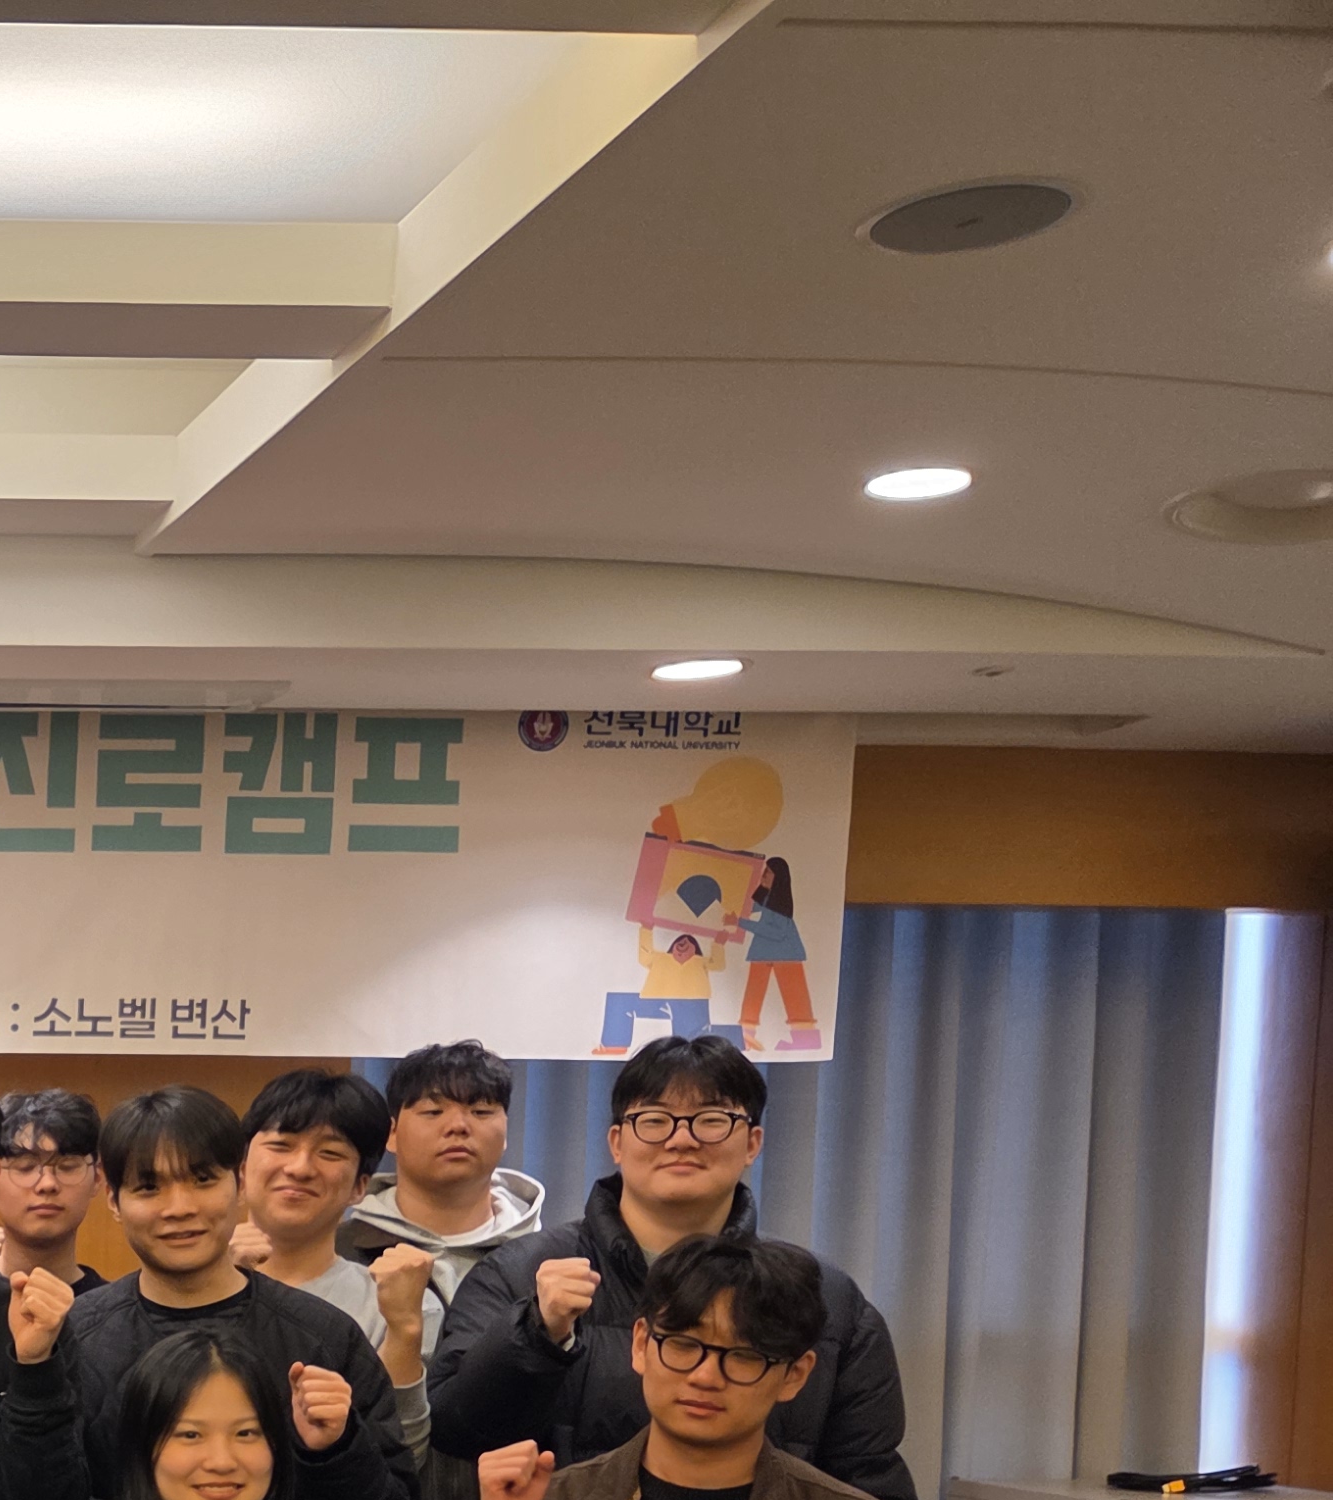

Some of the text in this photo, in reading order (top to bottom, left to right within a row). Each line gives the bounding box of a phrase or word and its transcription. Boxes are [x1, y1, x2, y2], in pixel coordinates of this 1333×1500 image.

[631, 740, 679, 750] NATIONAL
[682, 741, 741, 751] UNIVERSITY
[33, 998, 156, 1038] 소노벨
[171, 999, 250, 1039] 변산
